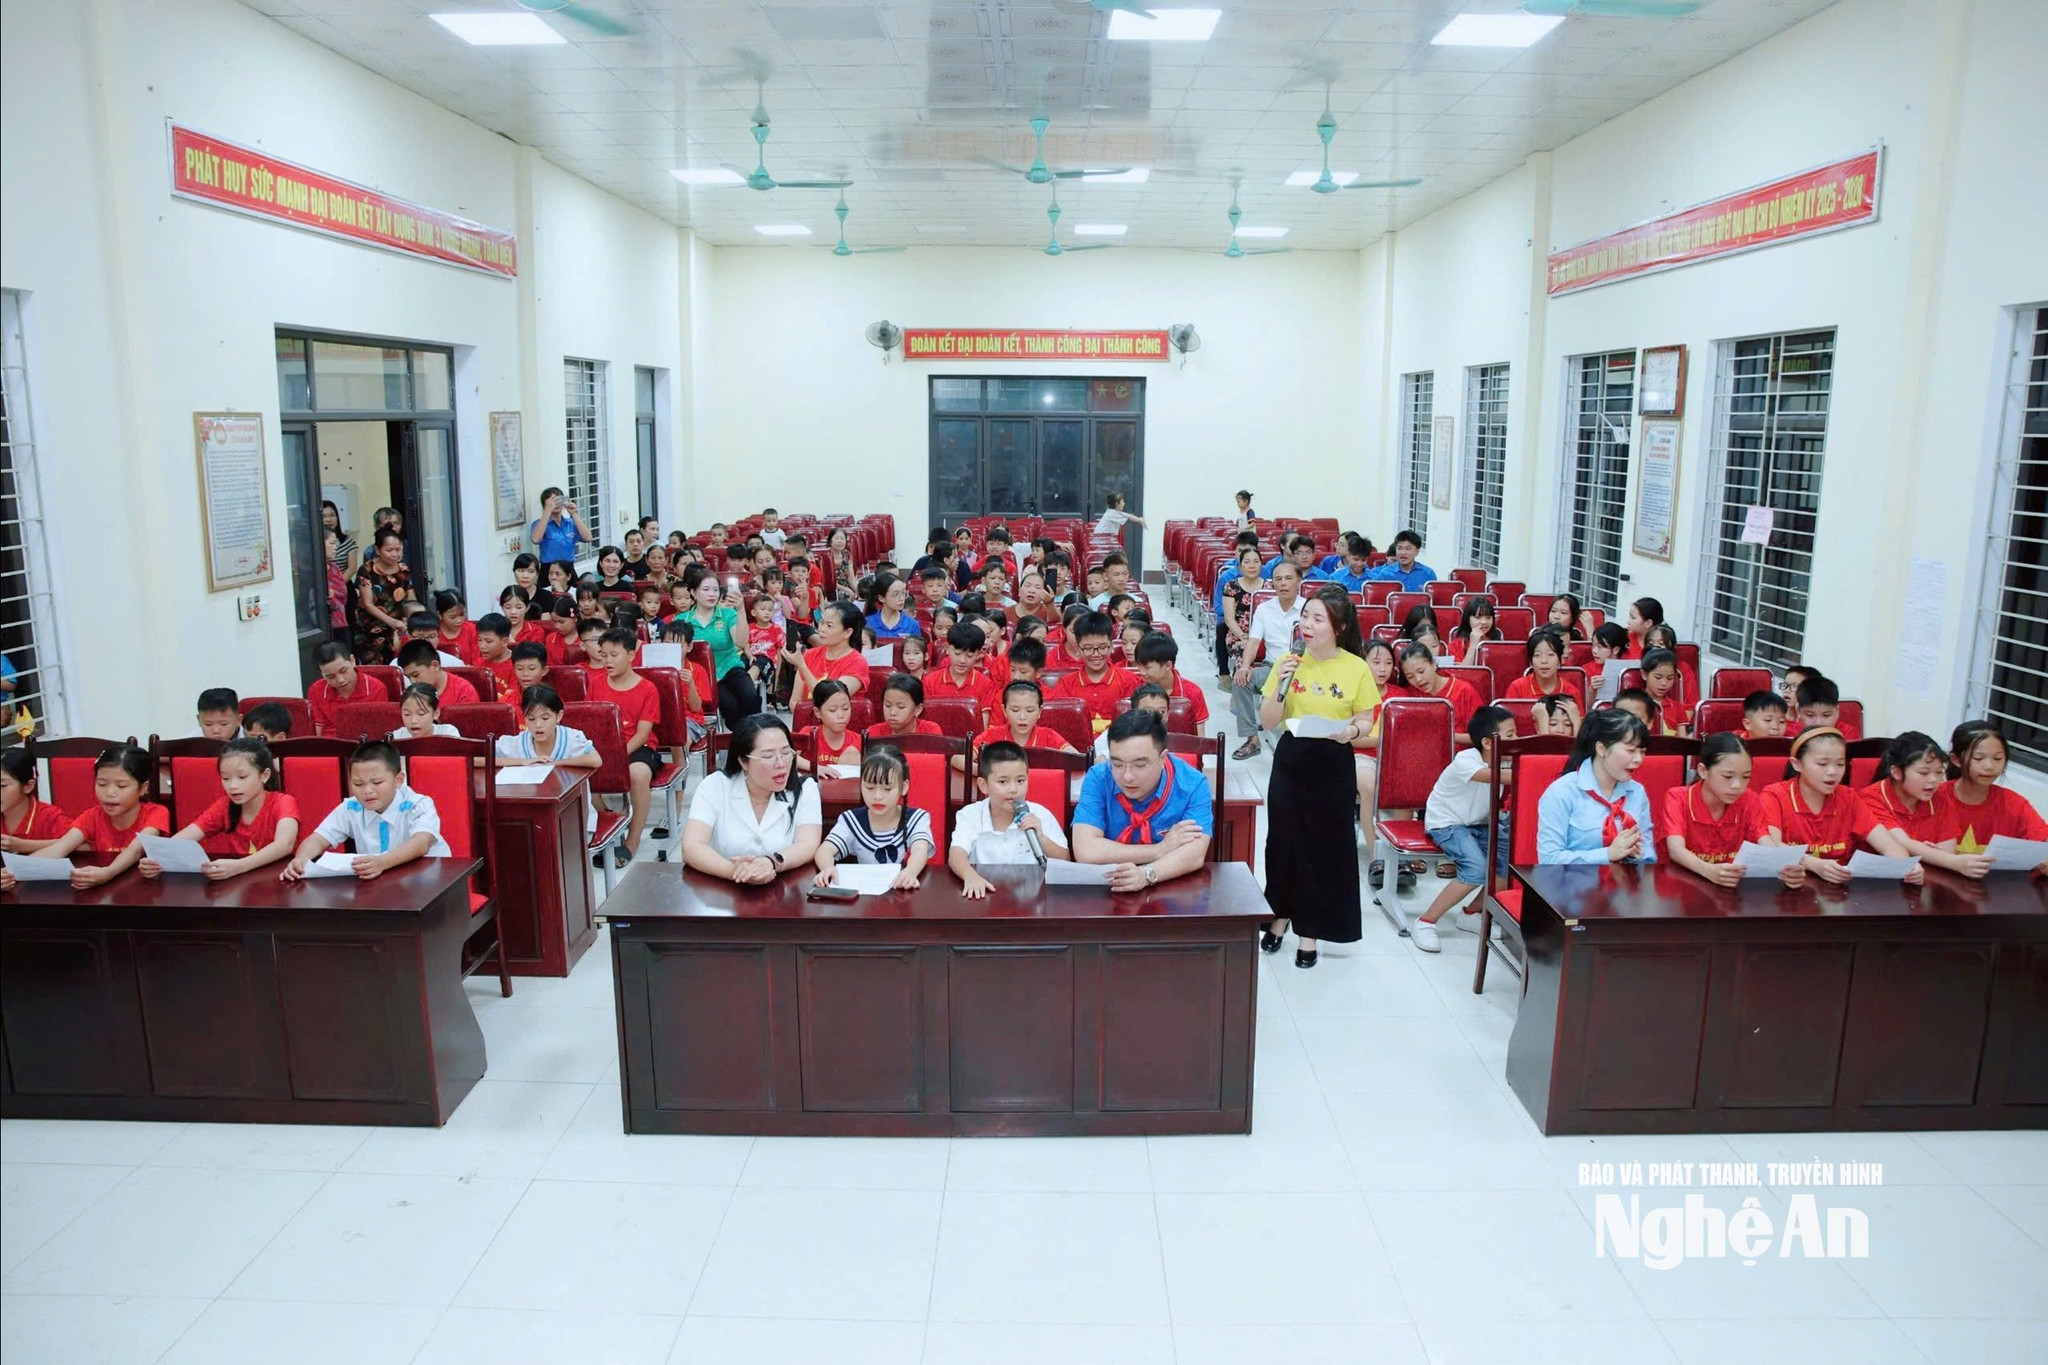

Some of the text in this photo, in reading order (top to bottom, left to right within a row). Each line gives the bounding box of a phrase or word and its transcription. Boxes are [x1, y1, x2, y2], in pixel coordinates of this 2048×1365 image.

[185, 146, 220, 188] PHÁT
[223, 158, 248, 196] HUY
[250, 164, 275, 202] SỨC
[276, 175, 308, 215] MẠNH
[310, 187, 329, 223] ĐẠI
[330, 191, 356, 225] ĐOÀN
[357, 196, 374, 231] KẾT
[1780, 187, 1805, 231] NHIỆM
[1816, 181, 1837, 217] 2025
[911, 331, 1161, 357] ĐOÀN KẾT ĐẠI ĐOÀN KẾT, THÀNH CÔNG ĐẠI THÀNH CÔNG
